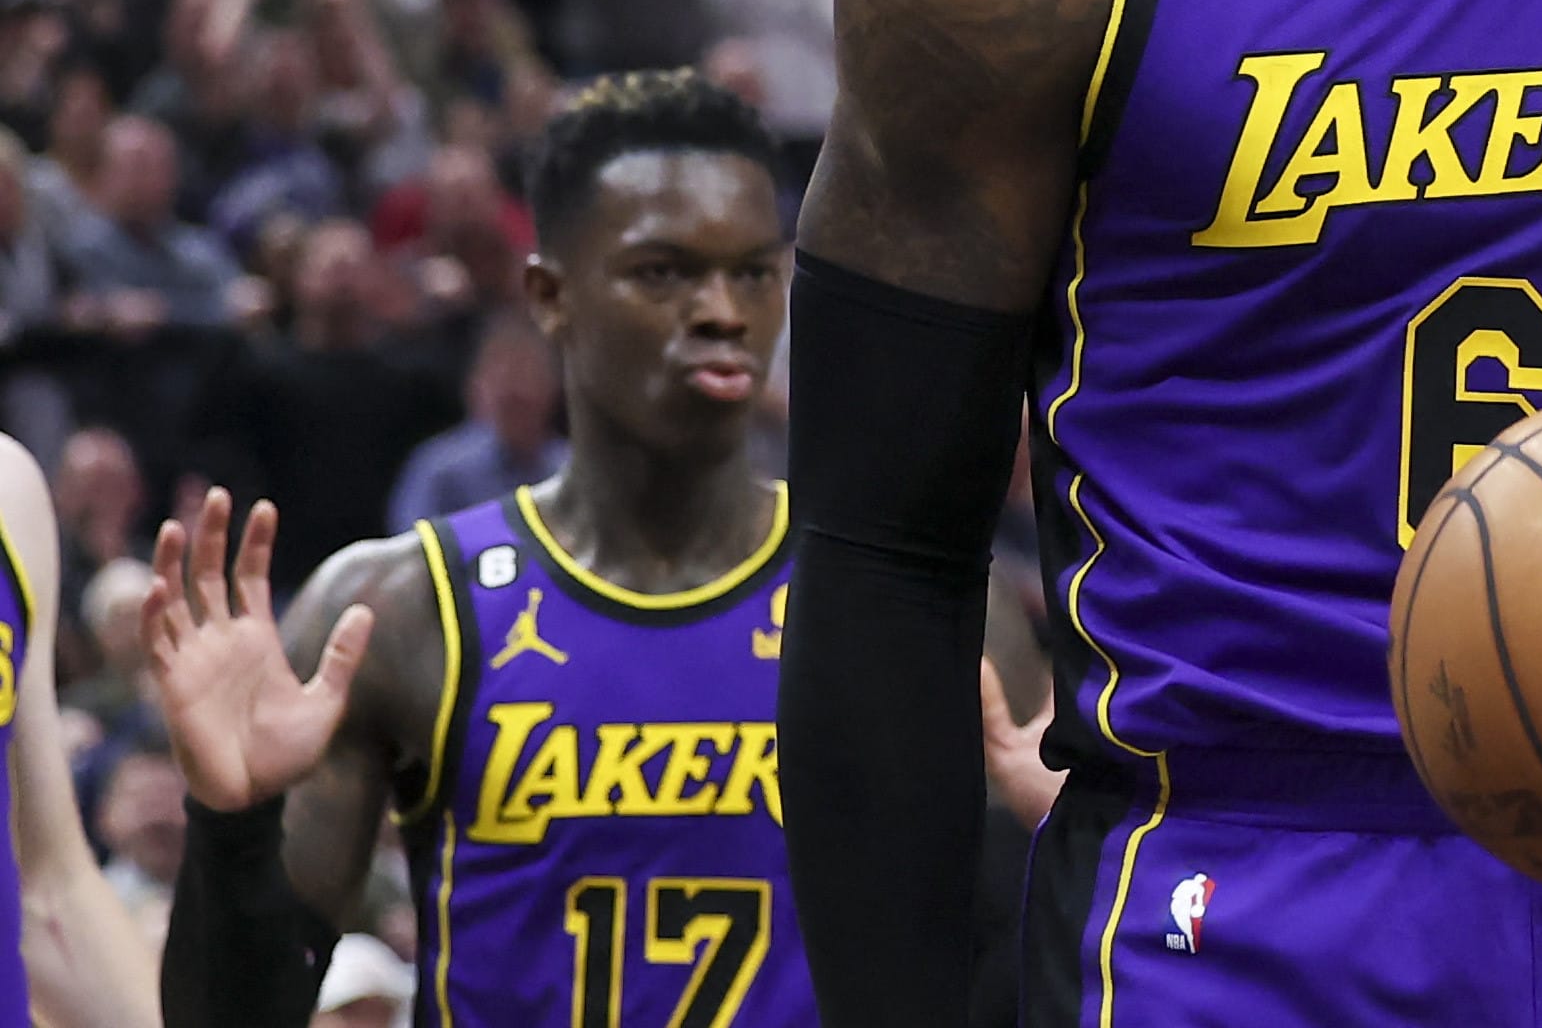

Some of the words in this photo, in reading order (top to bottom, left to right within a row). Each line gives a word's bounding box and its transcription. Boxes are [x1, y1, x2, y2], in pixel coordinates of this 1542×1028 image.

[467, 701, 785, 845] LAKER
[564, 876, 772, 1028] 17
[1166, 933, 1186, 950] NBA
